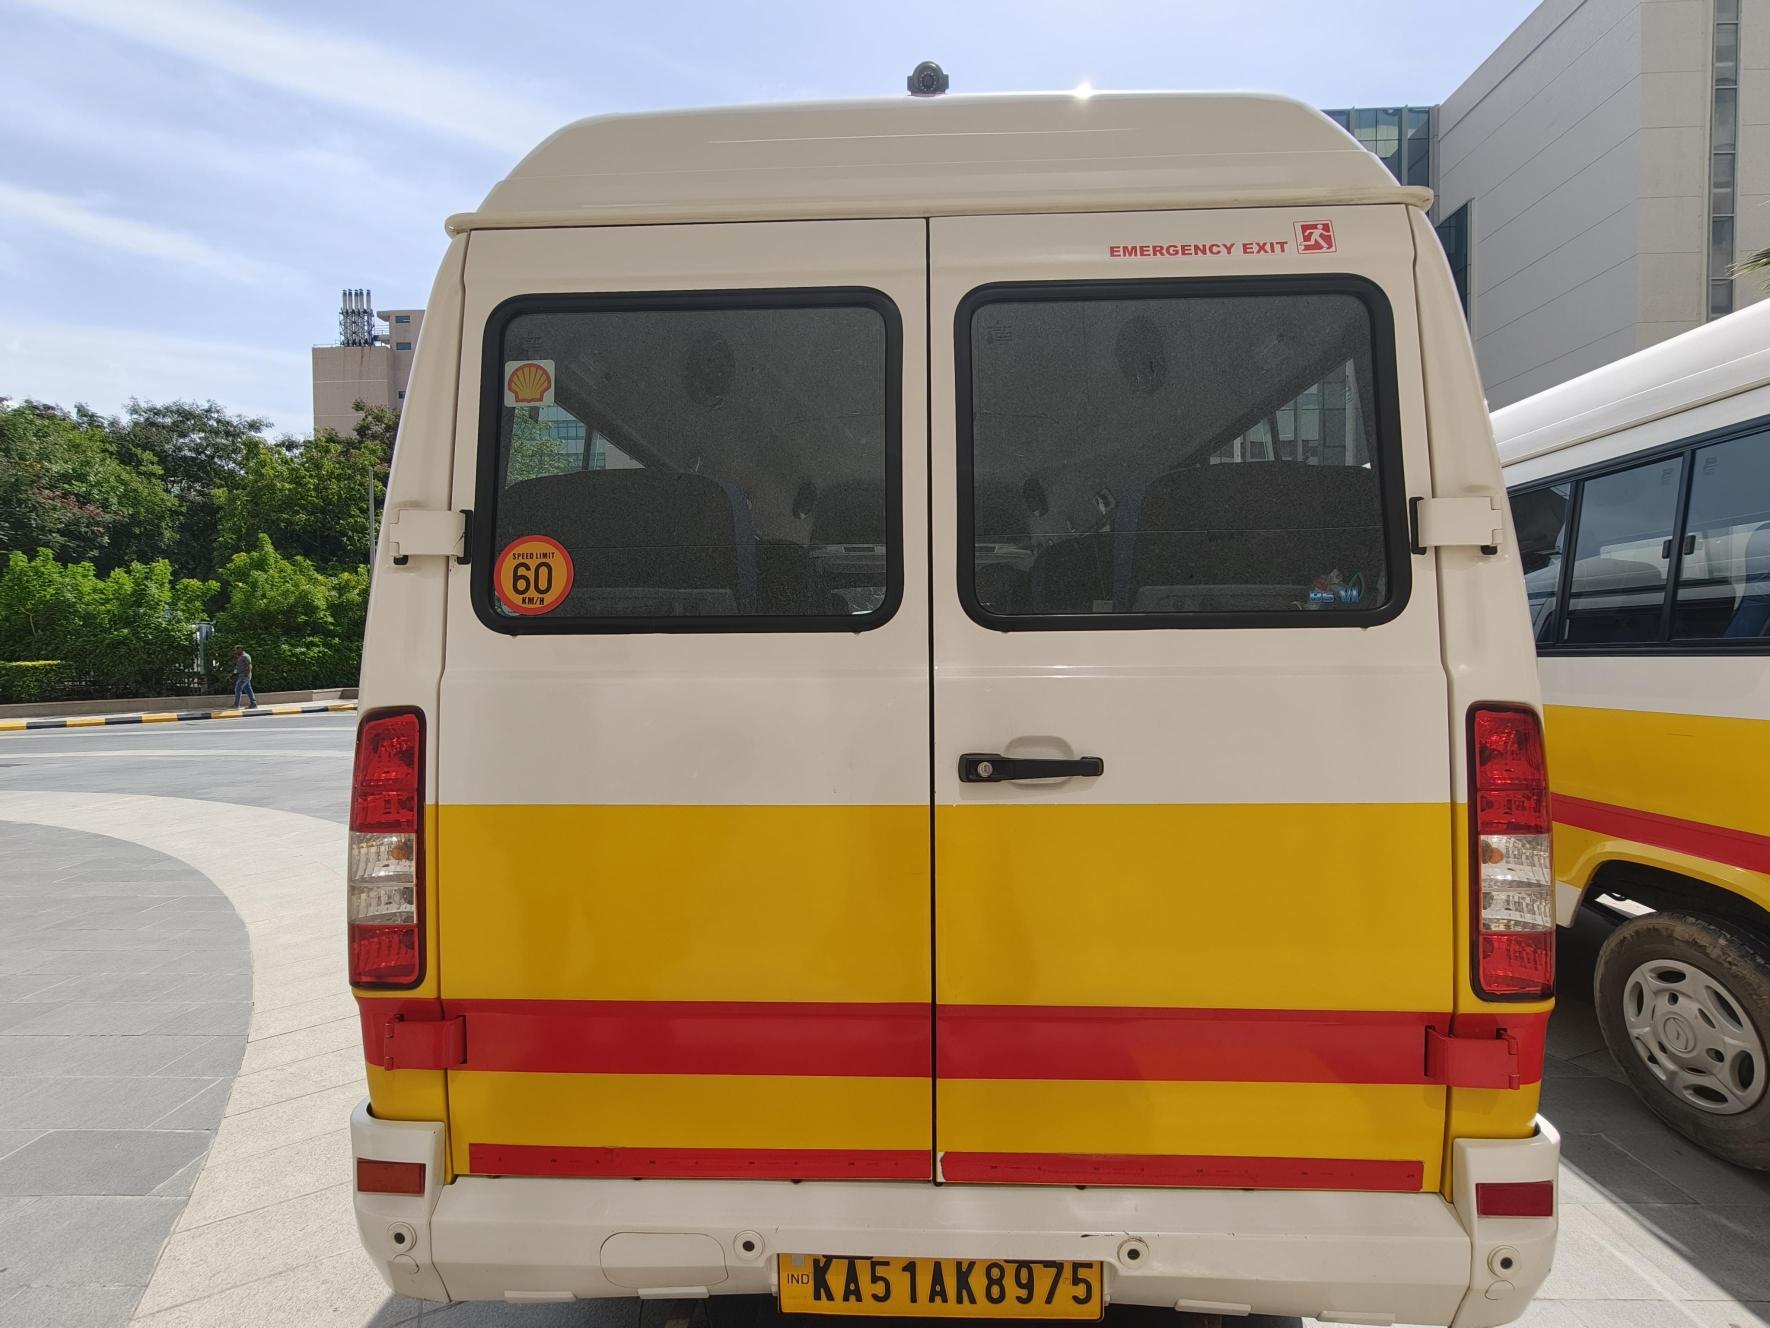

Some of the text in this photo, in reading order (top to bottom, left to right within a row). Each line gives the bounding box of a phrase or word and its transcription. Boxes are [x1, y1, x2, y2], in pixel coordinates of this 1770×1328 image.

[1109, 241, 1288, 257] EMERGENCY EXIT
[512, 552, 534, 560] SPEED
[512, 562, 553, 595] 60
[521, 597, 545, 605] KM/H
[787, 1258, 1093, 1305] IND KA51AK8975
